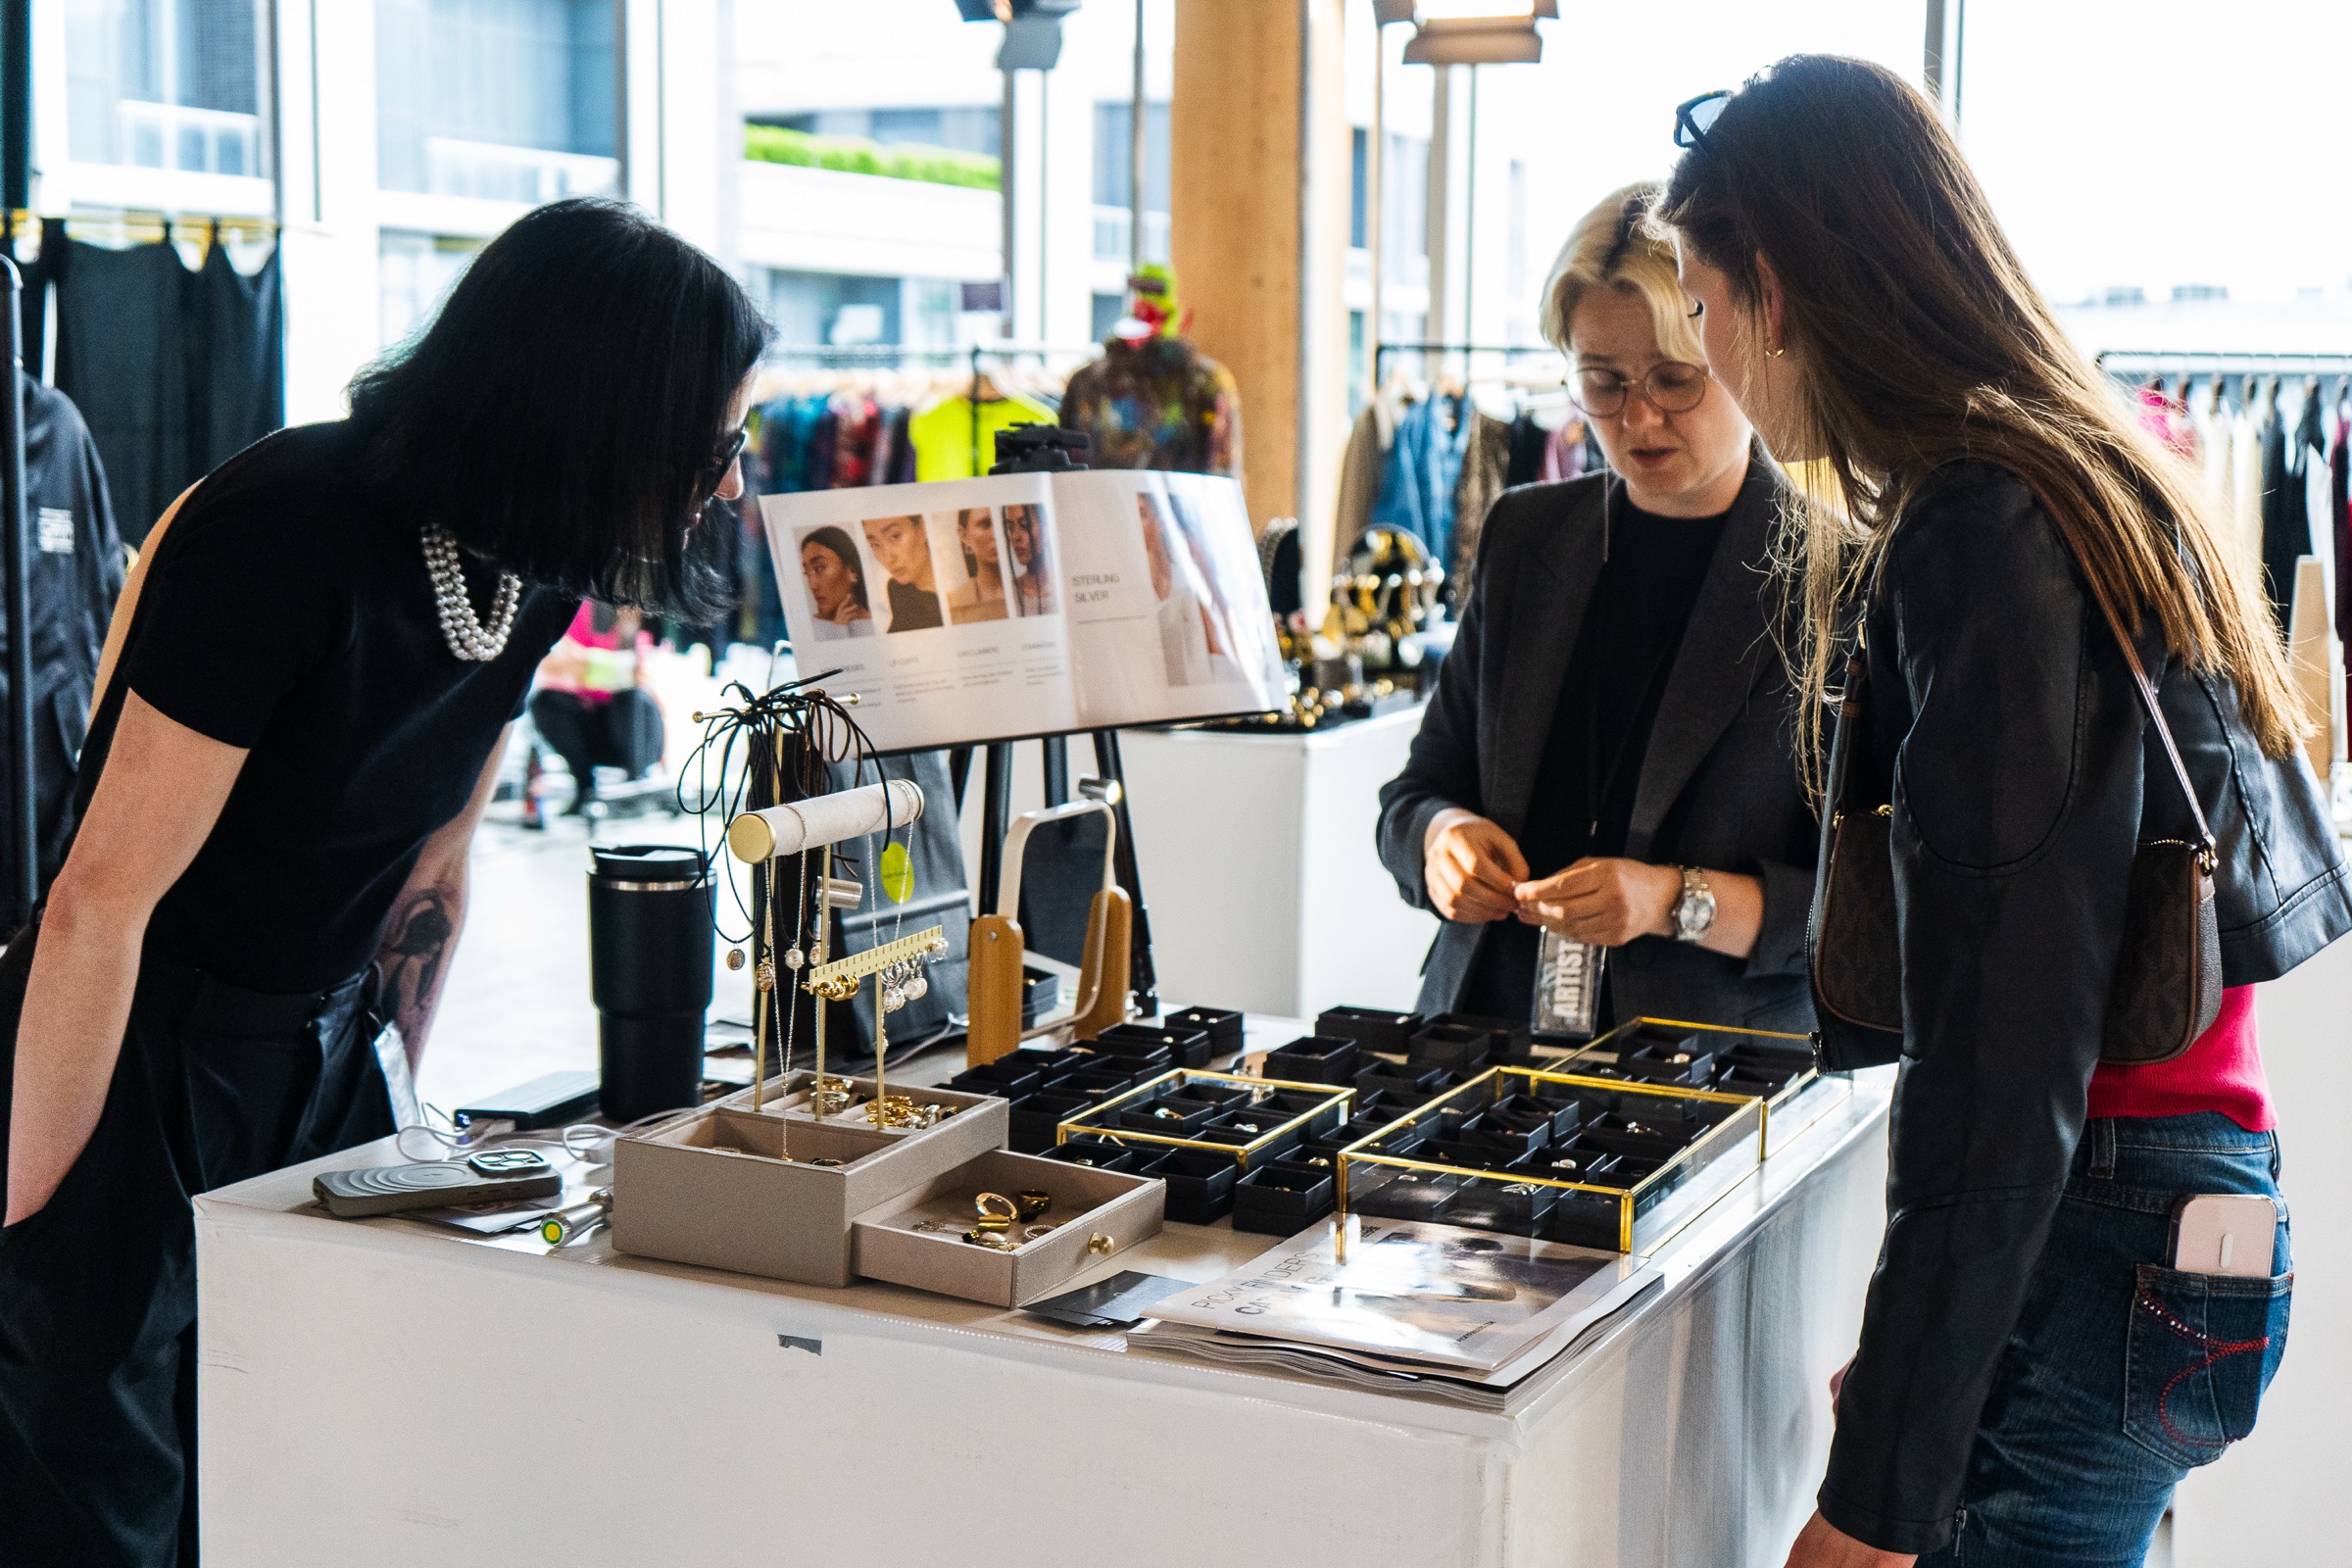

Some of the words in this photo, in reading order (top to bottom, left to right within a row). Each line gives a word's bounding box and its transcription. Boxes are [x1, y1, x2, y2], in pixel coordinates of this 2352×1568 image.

[1072, 573, 1120, 587] STERLING
[1075, 590, 1109, 603] SILVER
[1553, 941, 1585, 1018] ARTIST
[1191, 1287, 1243, 1309] PICKY
[1241, 1251, 1320, 1289] FINDERS
